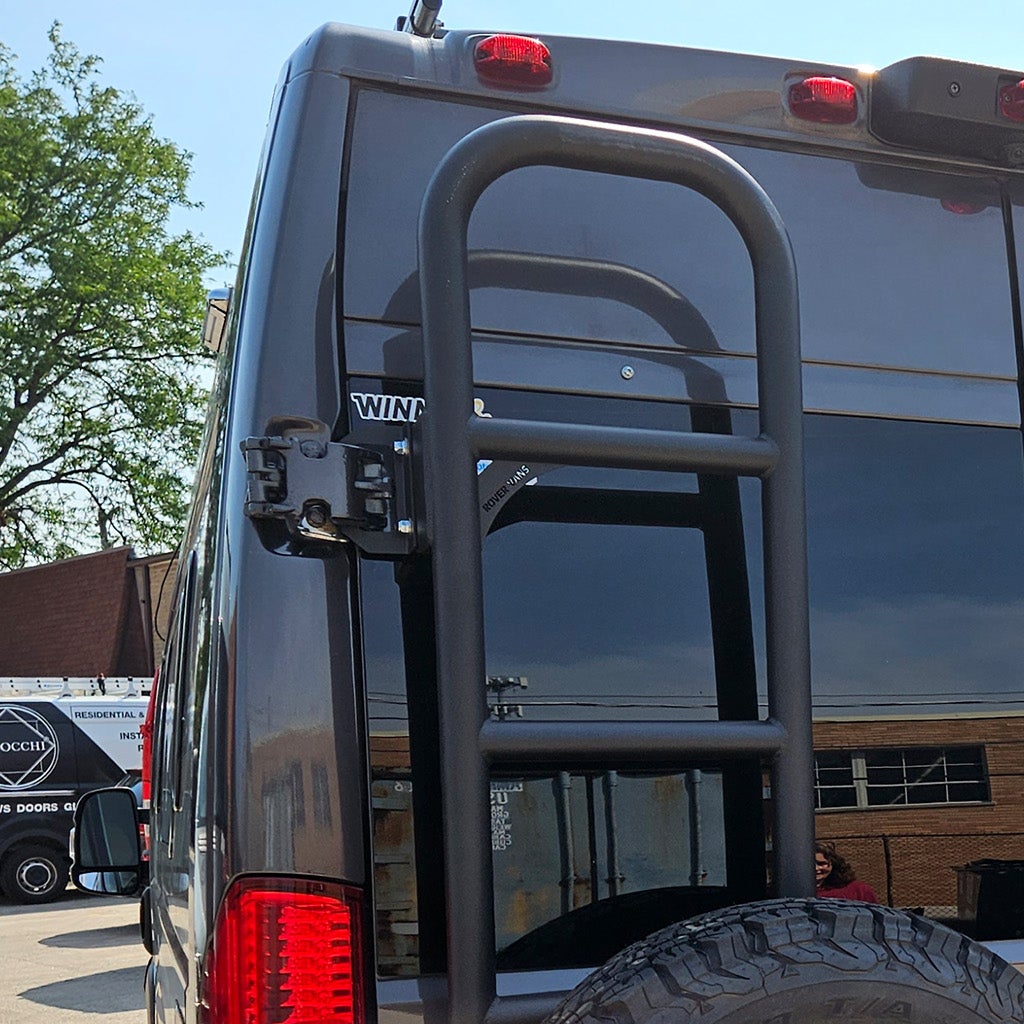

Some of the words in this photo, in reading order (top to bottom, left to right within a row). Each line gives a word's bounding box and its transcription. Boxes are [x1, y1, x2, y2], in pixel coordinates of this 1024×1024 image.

[482, 485, 509, 513] ROVER
[505, 464, 530, 486] VANS
[74, 711, 135, 720] RESIDENTIAL
[16, 802, 59, 813] DOORS
